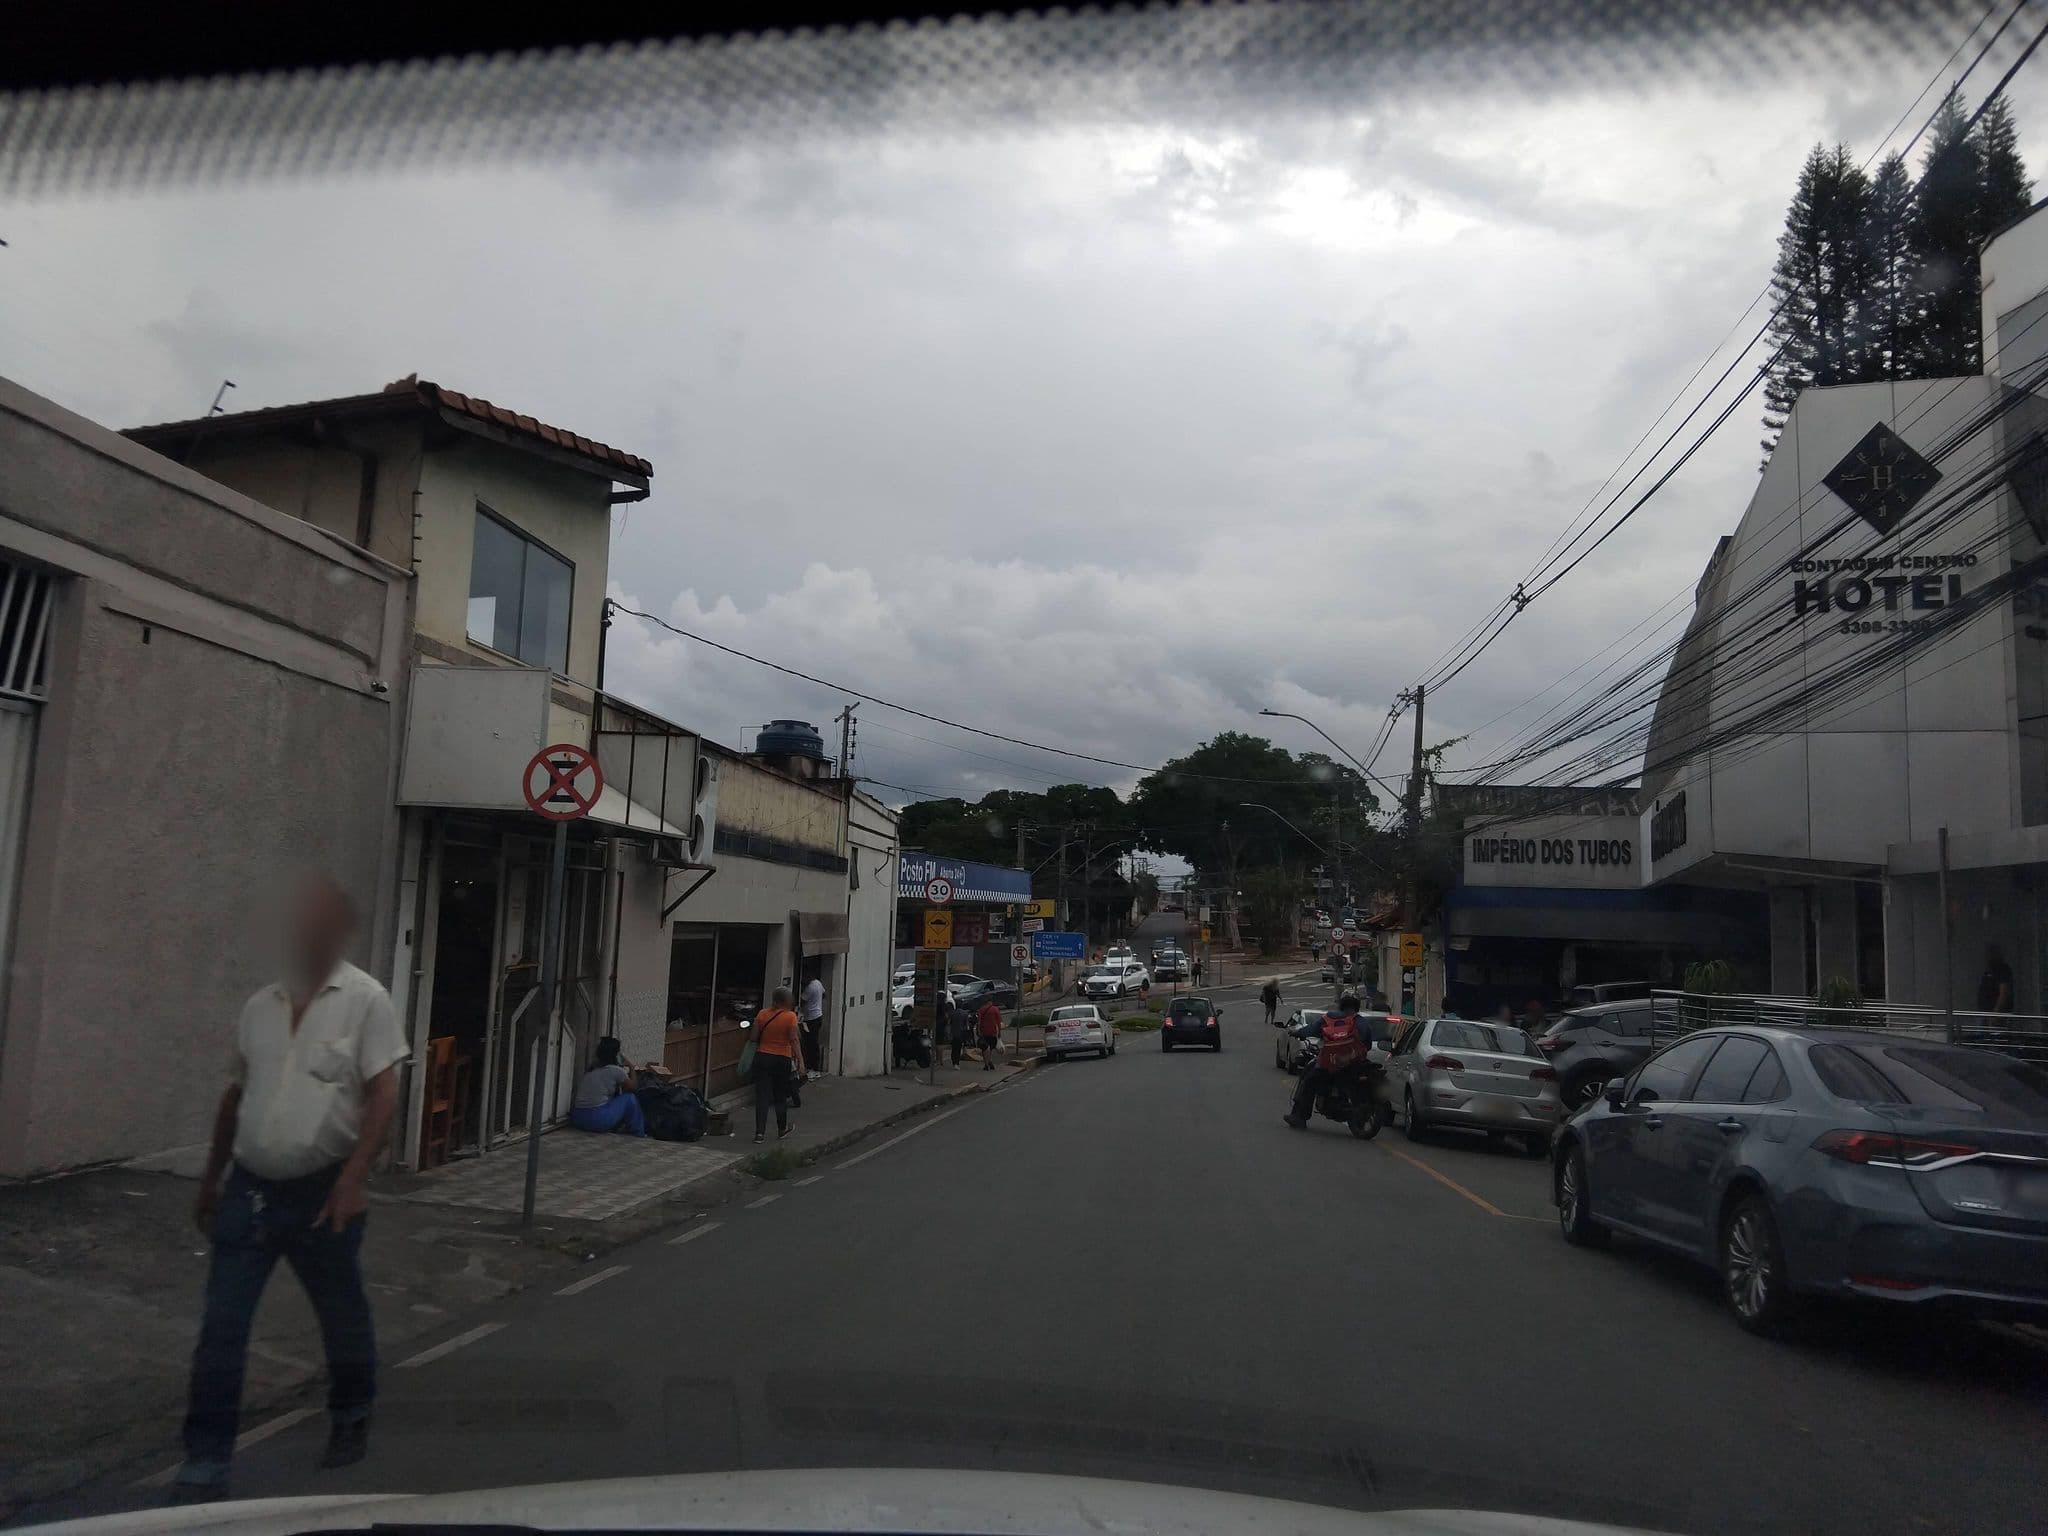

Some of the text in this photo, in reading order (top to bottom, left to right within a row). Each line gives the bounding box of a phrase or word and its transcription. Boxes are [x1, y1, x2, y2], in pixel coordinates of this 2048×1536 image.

[1790, 554, 1977, 573] CONTAGEM CENTRO
[1472, 832, 1632, 865] IMPÉRIO DOS TUBOS
[900, 857, 924, 882] Posto
[925, 860, 936, 882] FM
[930, 884, 949, 896] 30
